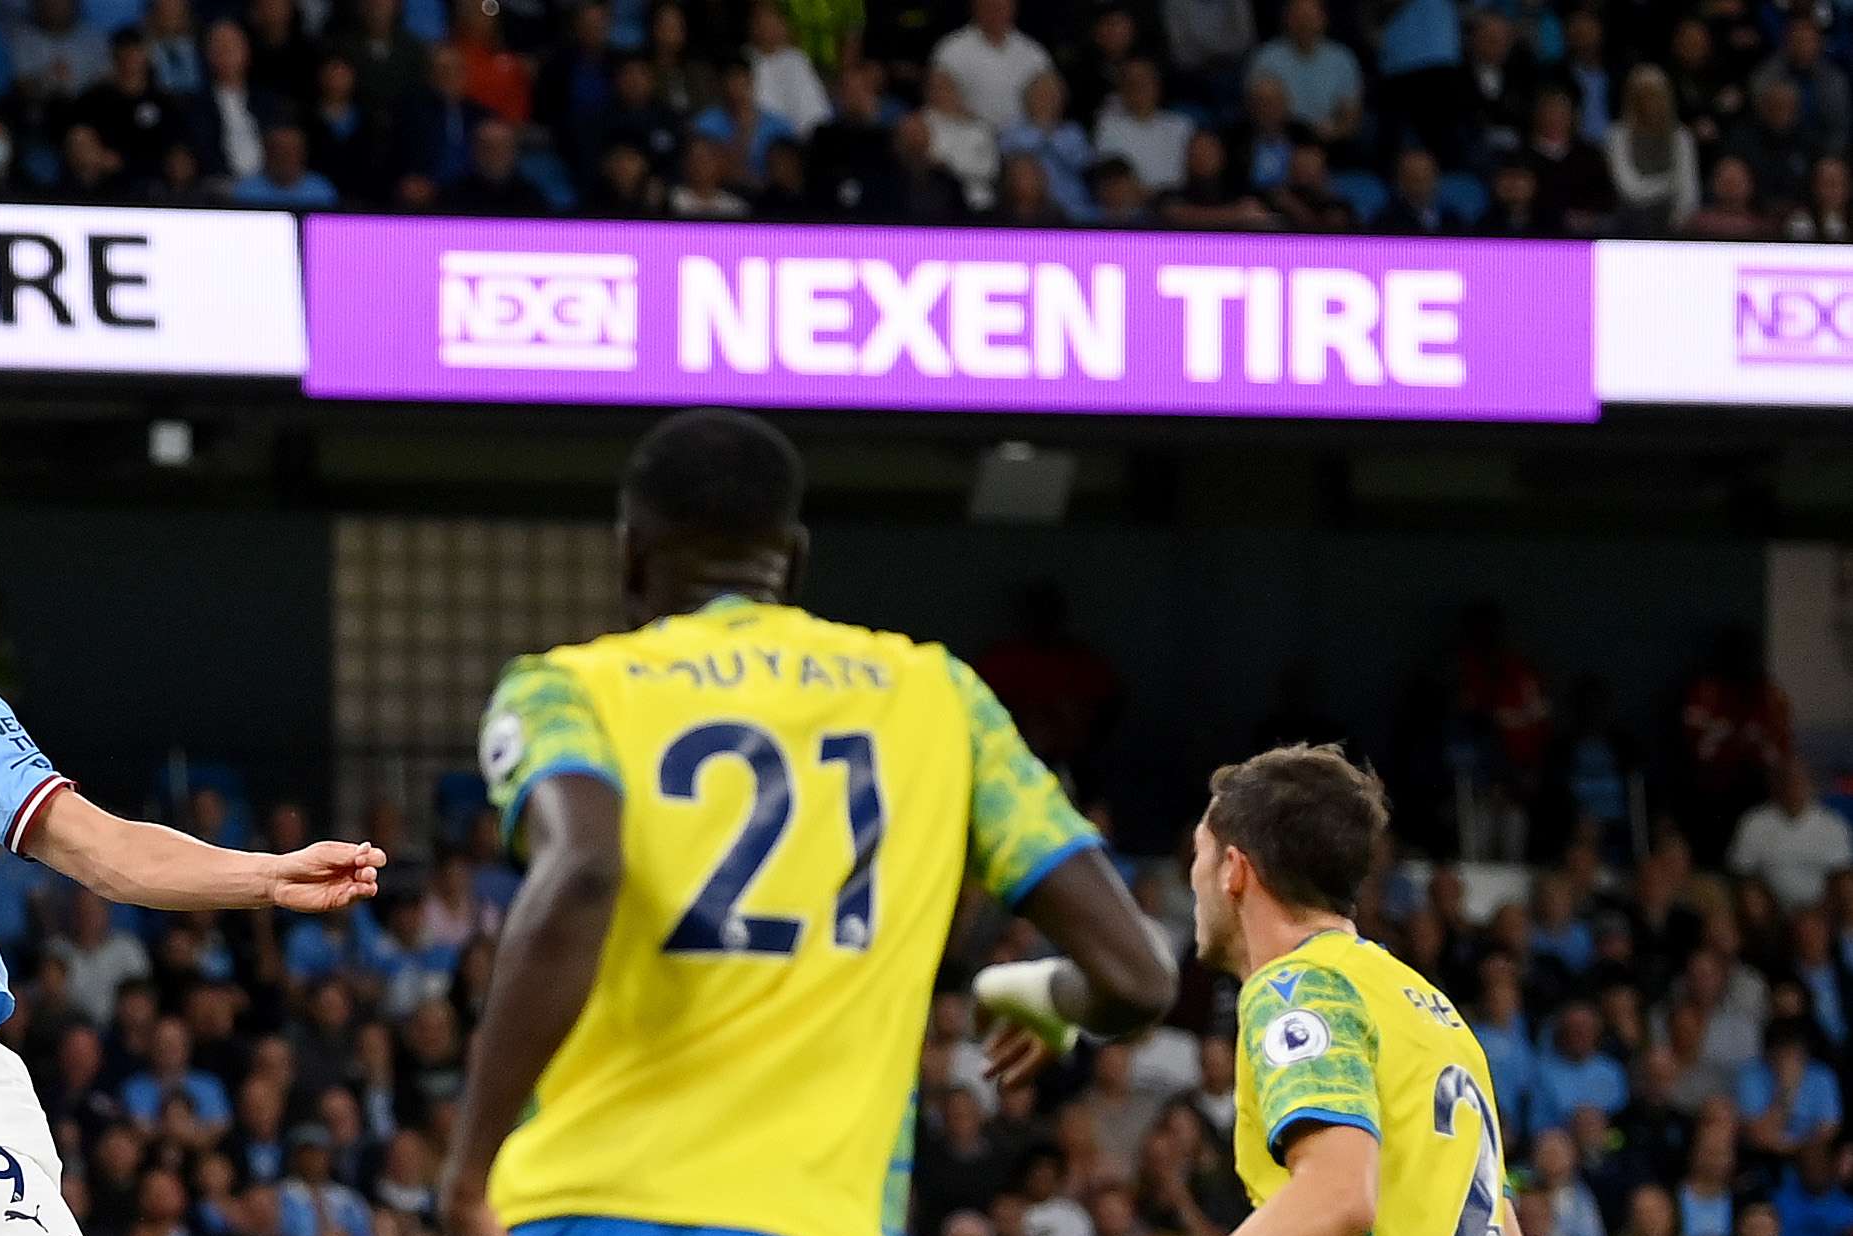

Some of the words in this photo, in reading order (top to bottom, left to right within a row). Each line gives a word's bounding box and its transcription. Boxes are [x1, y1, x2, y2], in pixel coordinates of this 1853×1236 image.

[678, 256, 1125, 379] NEXEN
[1157, 266, 1466, 386] TIRE
[658, 721, 883, 954] 21
